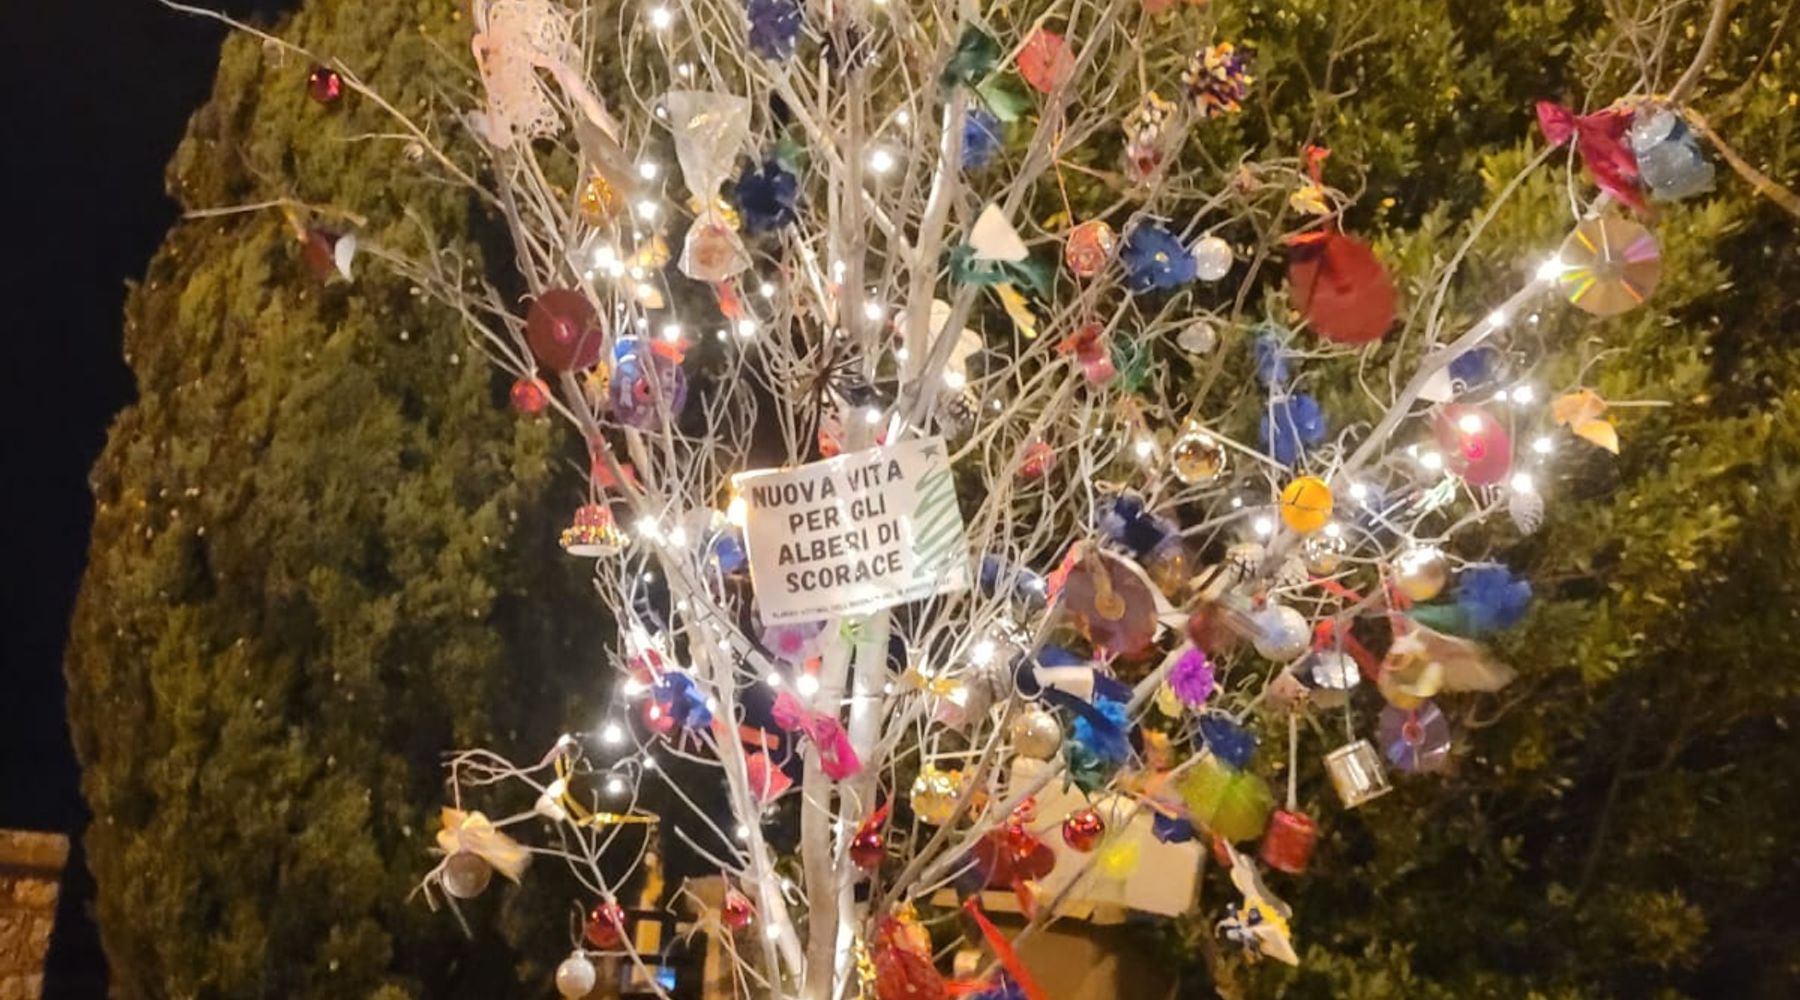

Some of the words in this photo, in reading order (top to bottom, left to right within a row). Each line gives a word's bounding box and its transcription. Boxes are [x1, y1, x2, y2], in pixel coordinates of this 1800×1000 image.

[751, 475, 837, 509] NUOVA
[847, 458, 903, 491] VITA
[788, 506, 839, 534] PER
[852, 493, 886, 521] GLI
[778, 529, 869, 567] ALBERI
[877, 520, 900, 543] DI
[786, 550, 903, 593] SCORACE
